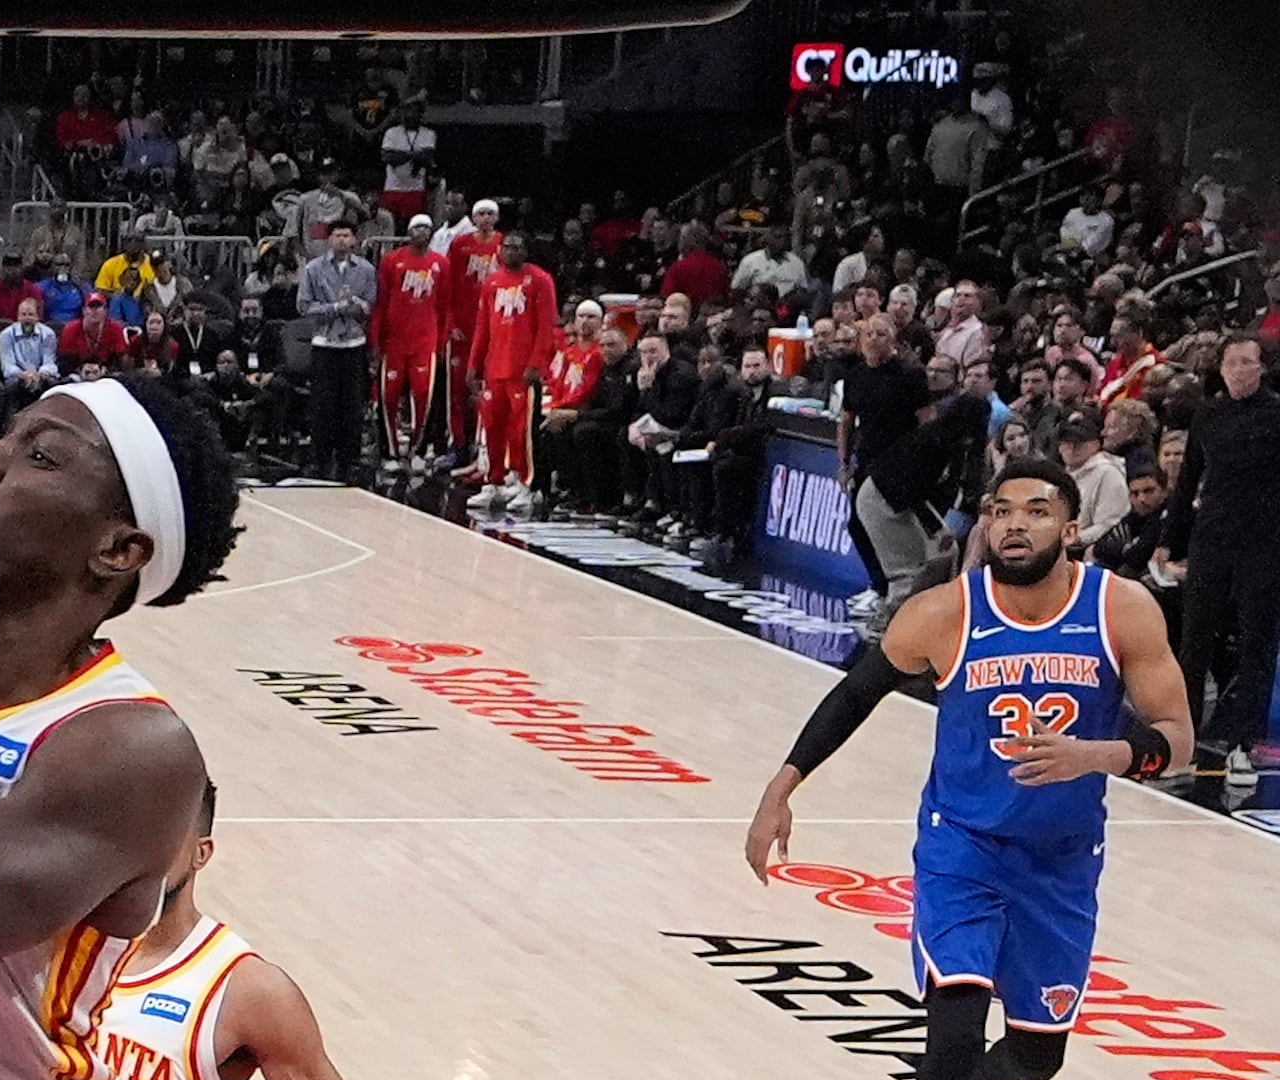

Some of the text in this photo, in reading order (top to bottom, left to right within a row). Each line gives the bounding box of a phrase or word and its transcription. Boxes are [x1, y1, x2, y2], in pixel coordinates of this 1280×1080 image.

[965, 653, 1100, 692] NEW YORK
[235, 668, 440, 737] ARENA
[988, 692, 1079, 760] 32
[143, 997, 187, 1017] paze
